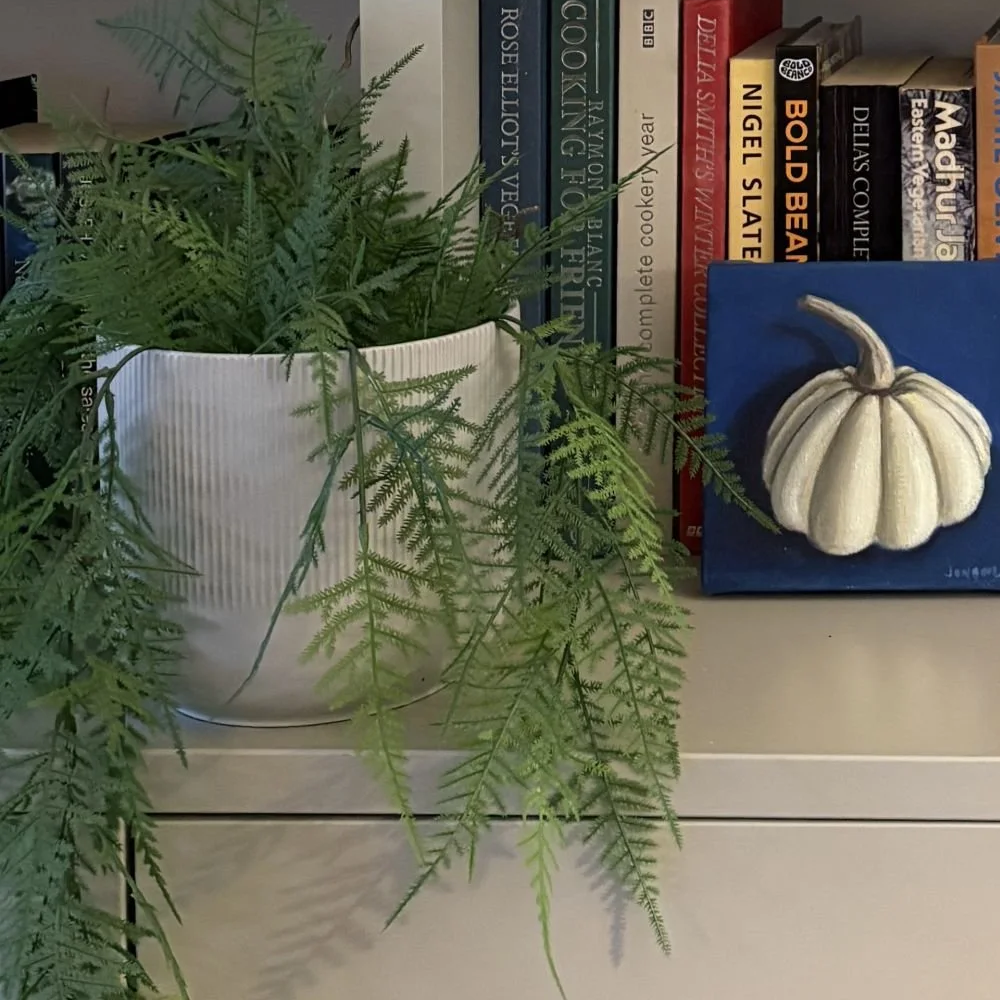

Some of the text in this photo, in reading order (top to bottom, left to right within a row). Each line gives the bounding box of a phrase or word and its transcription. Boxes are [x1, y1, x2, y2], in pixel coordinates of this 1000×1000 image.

[643, 9, 654, 47] BBC
[781, 60, 811, 69] BOLD
[501, 7, 519, 166] ROSE ELLIOT'S
[561, 0, 587, 158] COOKING
[640, 113, 659, 157] year
[693, 13, 717, 279] DELIA SMITH'S WINTER
[742, 84, 762, 261] NIGEL SLATE
[785, 100, 808, 183] BOLD
[852, 107, 869, 171] DELIA'S
[910, 98, 928, 259] Eastern Vegetarian
[934, 101, 964, 225] Madhur
[635, 160, 658, 246] cookery
[587, 218, 603, 288] BLANC
[633, 255, 658, 354] complete
